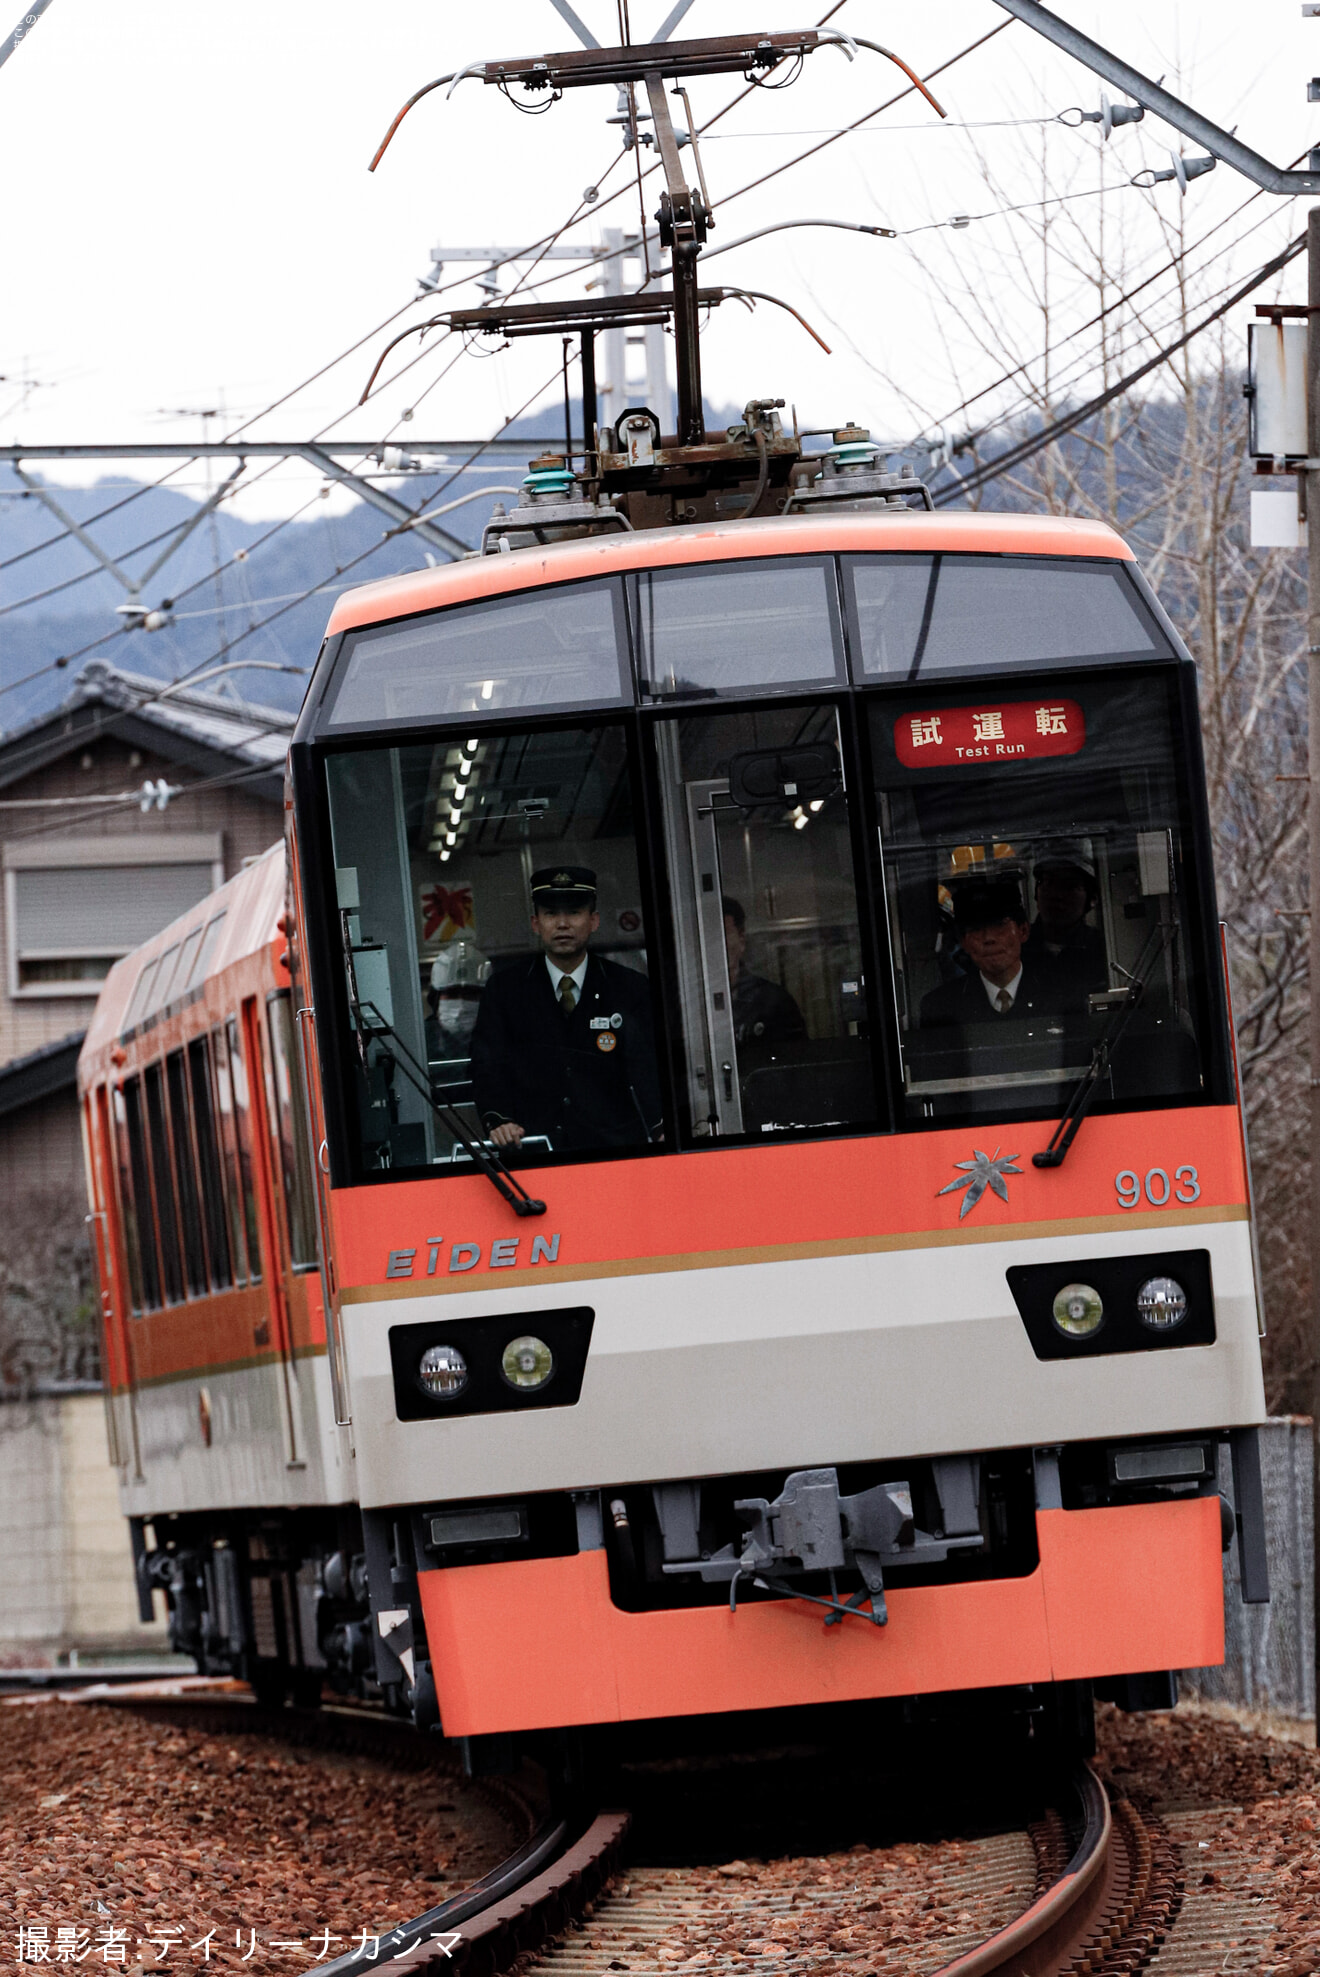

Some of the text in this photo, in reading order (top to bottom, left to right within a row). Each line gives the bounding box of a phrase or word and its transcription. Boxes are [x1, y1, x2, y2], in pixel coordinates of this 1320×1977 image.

[911, 707, 1068, 747] 試運転
[955, 743, 1025, 758] Test Run
[1115, 1165, 1201, 1208] 903
